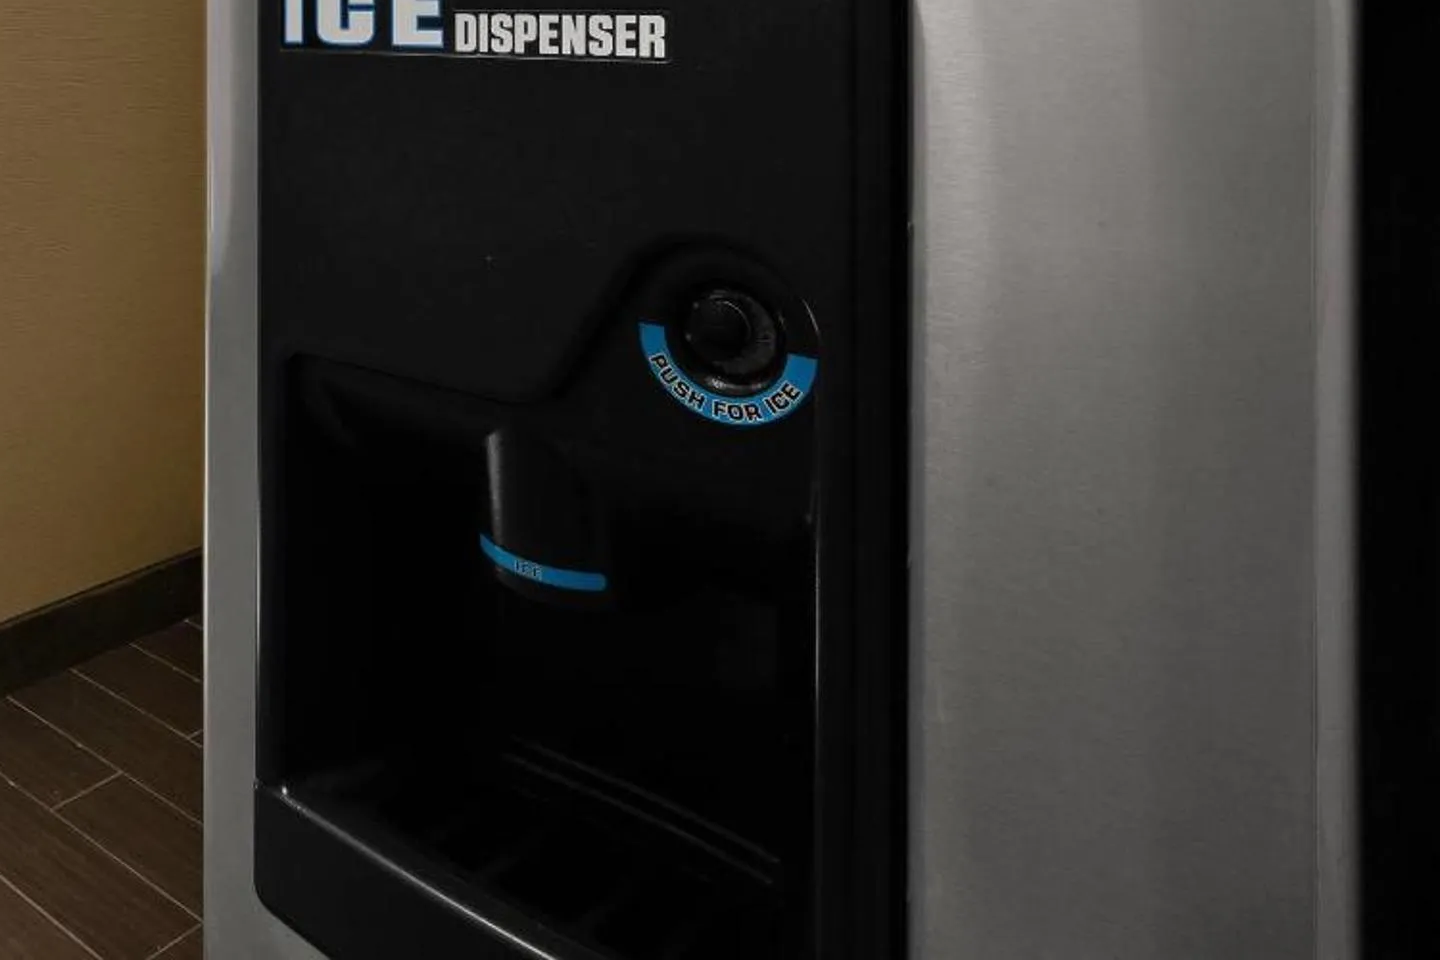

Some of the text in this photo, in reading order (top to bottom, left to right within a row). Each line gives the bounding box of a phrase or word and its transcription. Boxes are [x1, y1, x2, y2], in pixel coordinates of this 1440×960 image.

[454, 12, 667, 59] DISPENSER
[649, 352, 803, 422] PUSH FOR ICE
